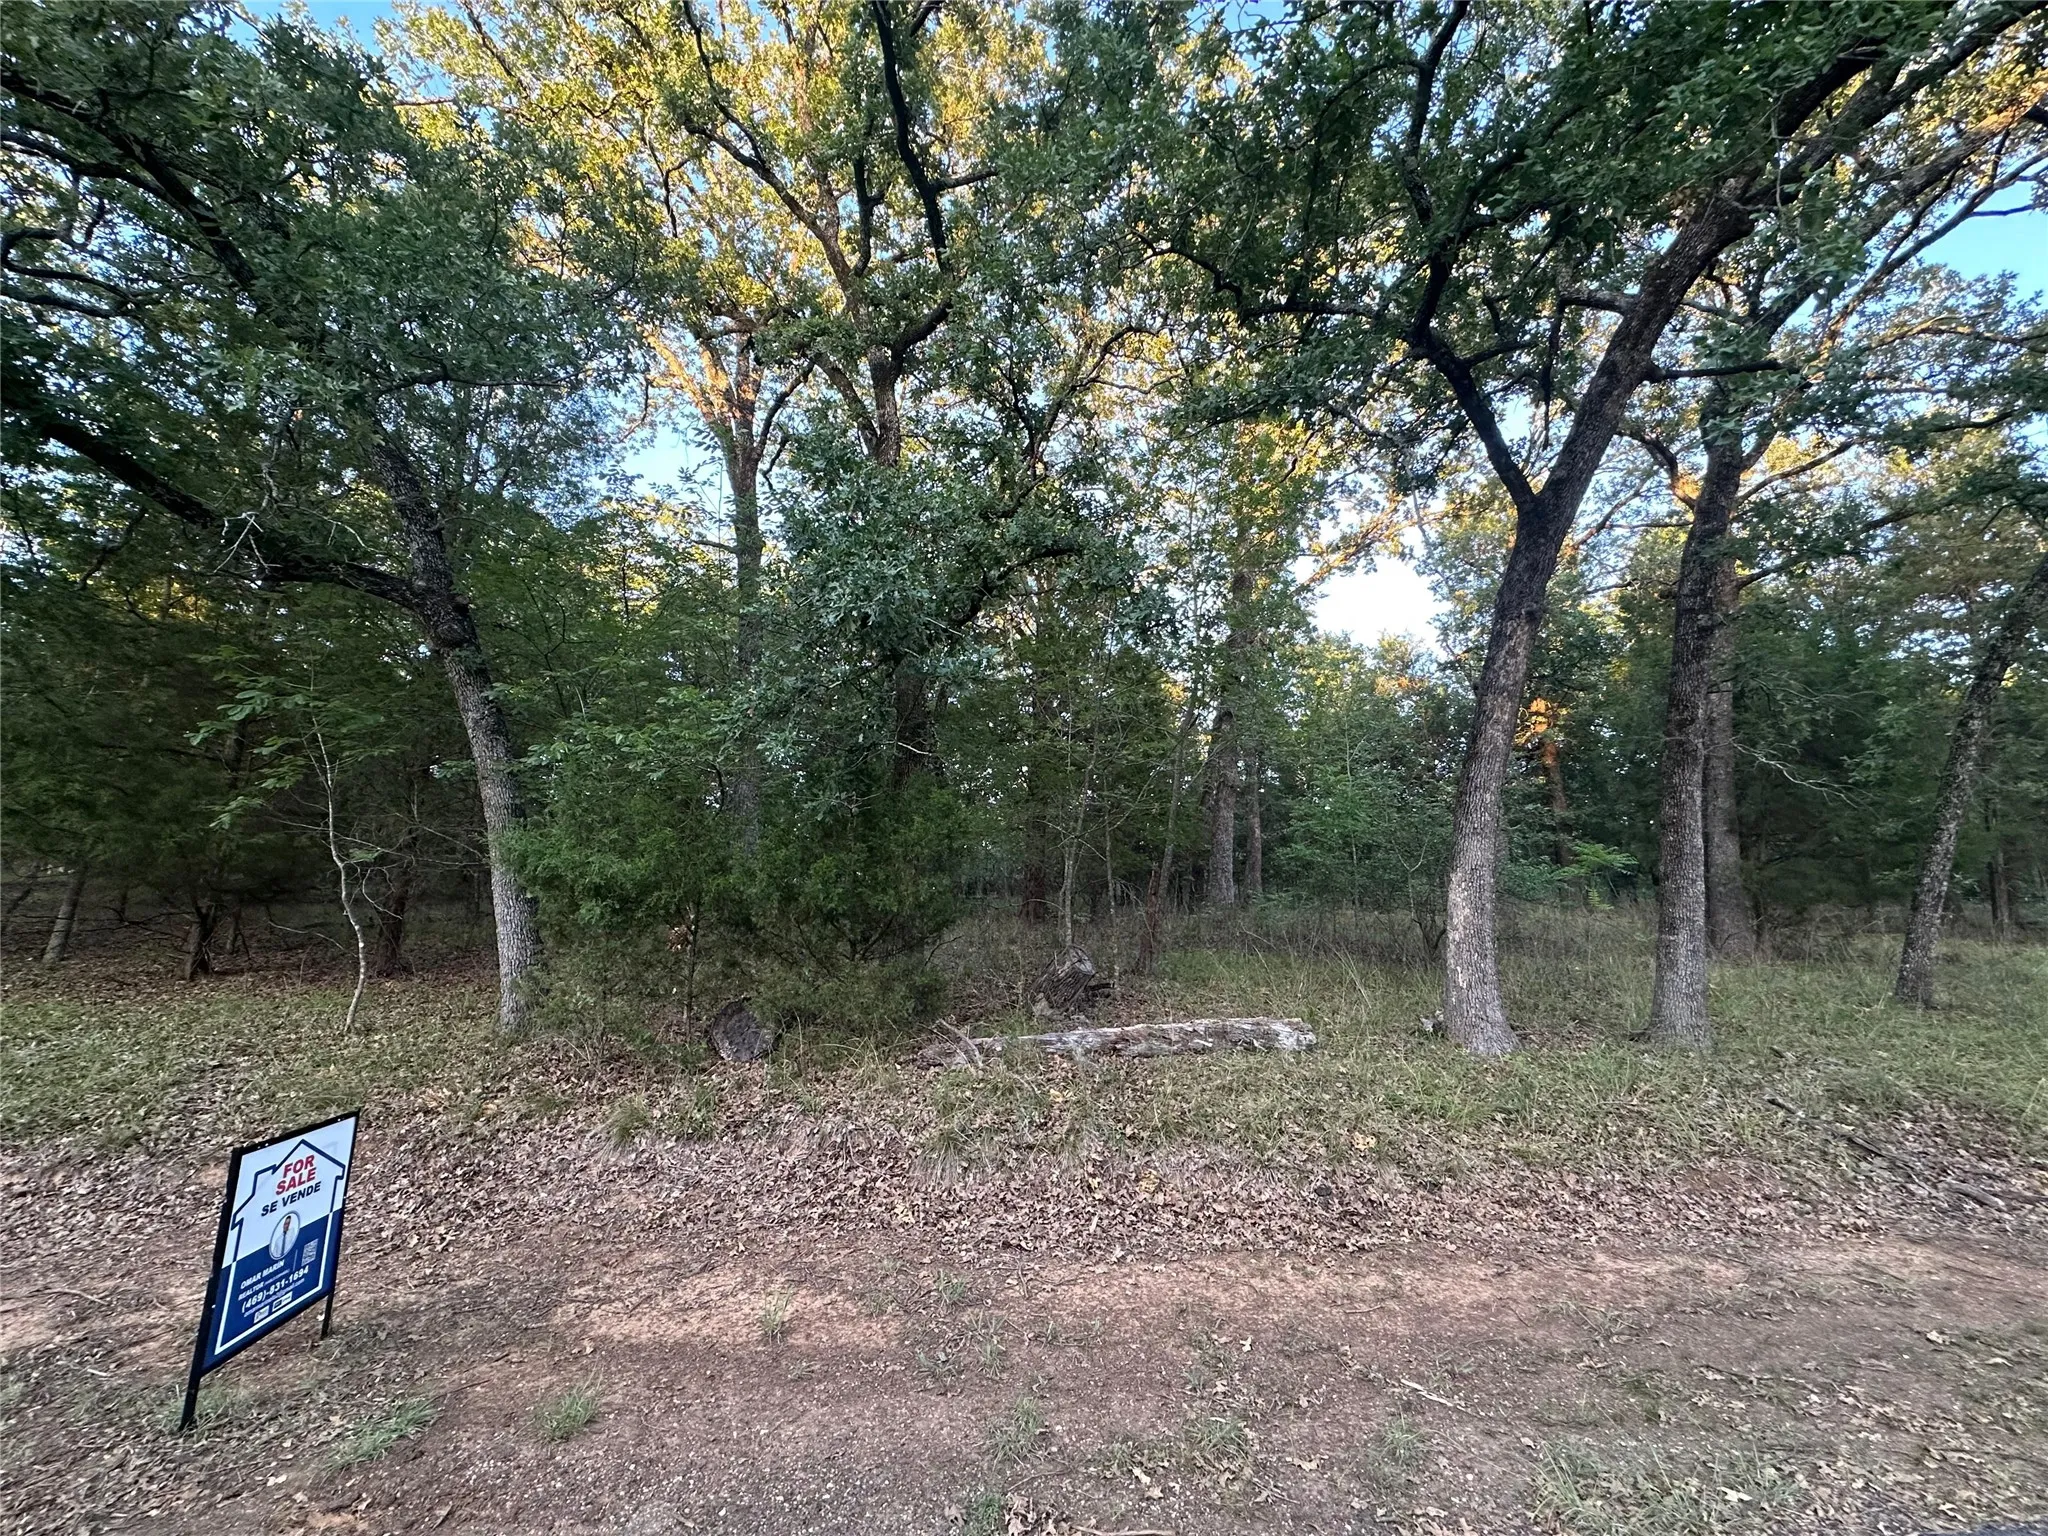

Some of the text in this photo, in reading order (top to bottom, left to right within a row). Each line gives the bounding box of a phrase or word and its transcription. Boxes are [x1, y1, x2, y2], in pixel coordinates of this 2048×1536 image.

[283, 1155, 315, 1178] FOR
[276, 1167, 316, 1196] SALE
[261, 1181, 321, 1217] SE VENDE
[238, 1281, 265, 1301] REALTOR
[241, 1272, 261, 1290] OMAR
[241, 1265, 309, 1314] (469)-831-1694
